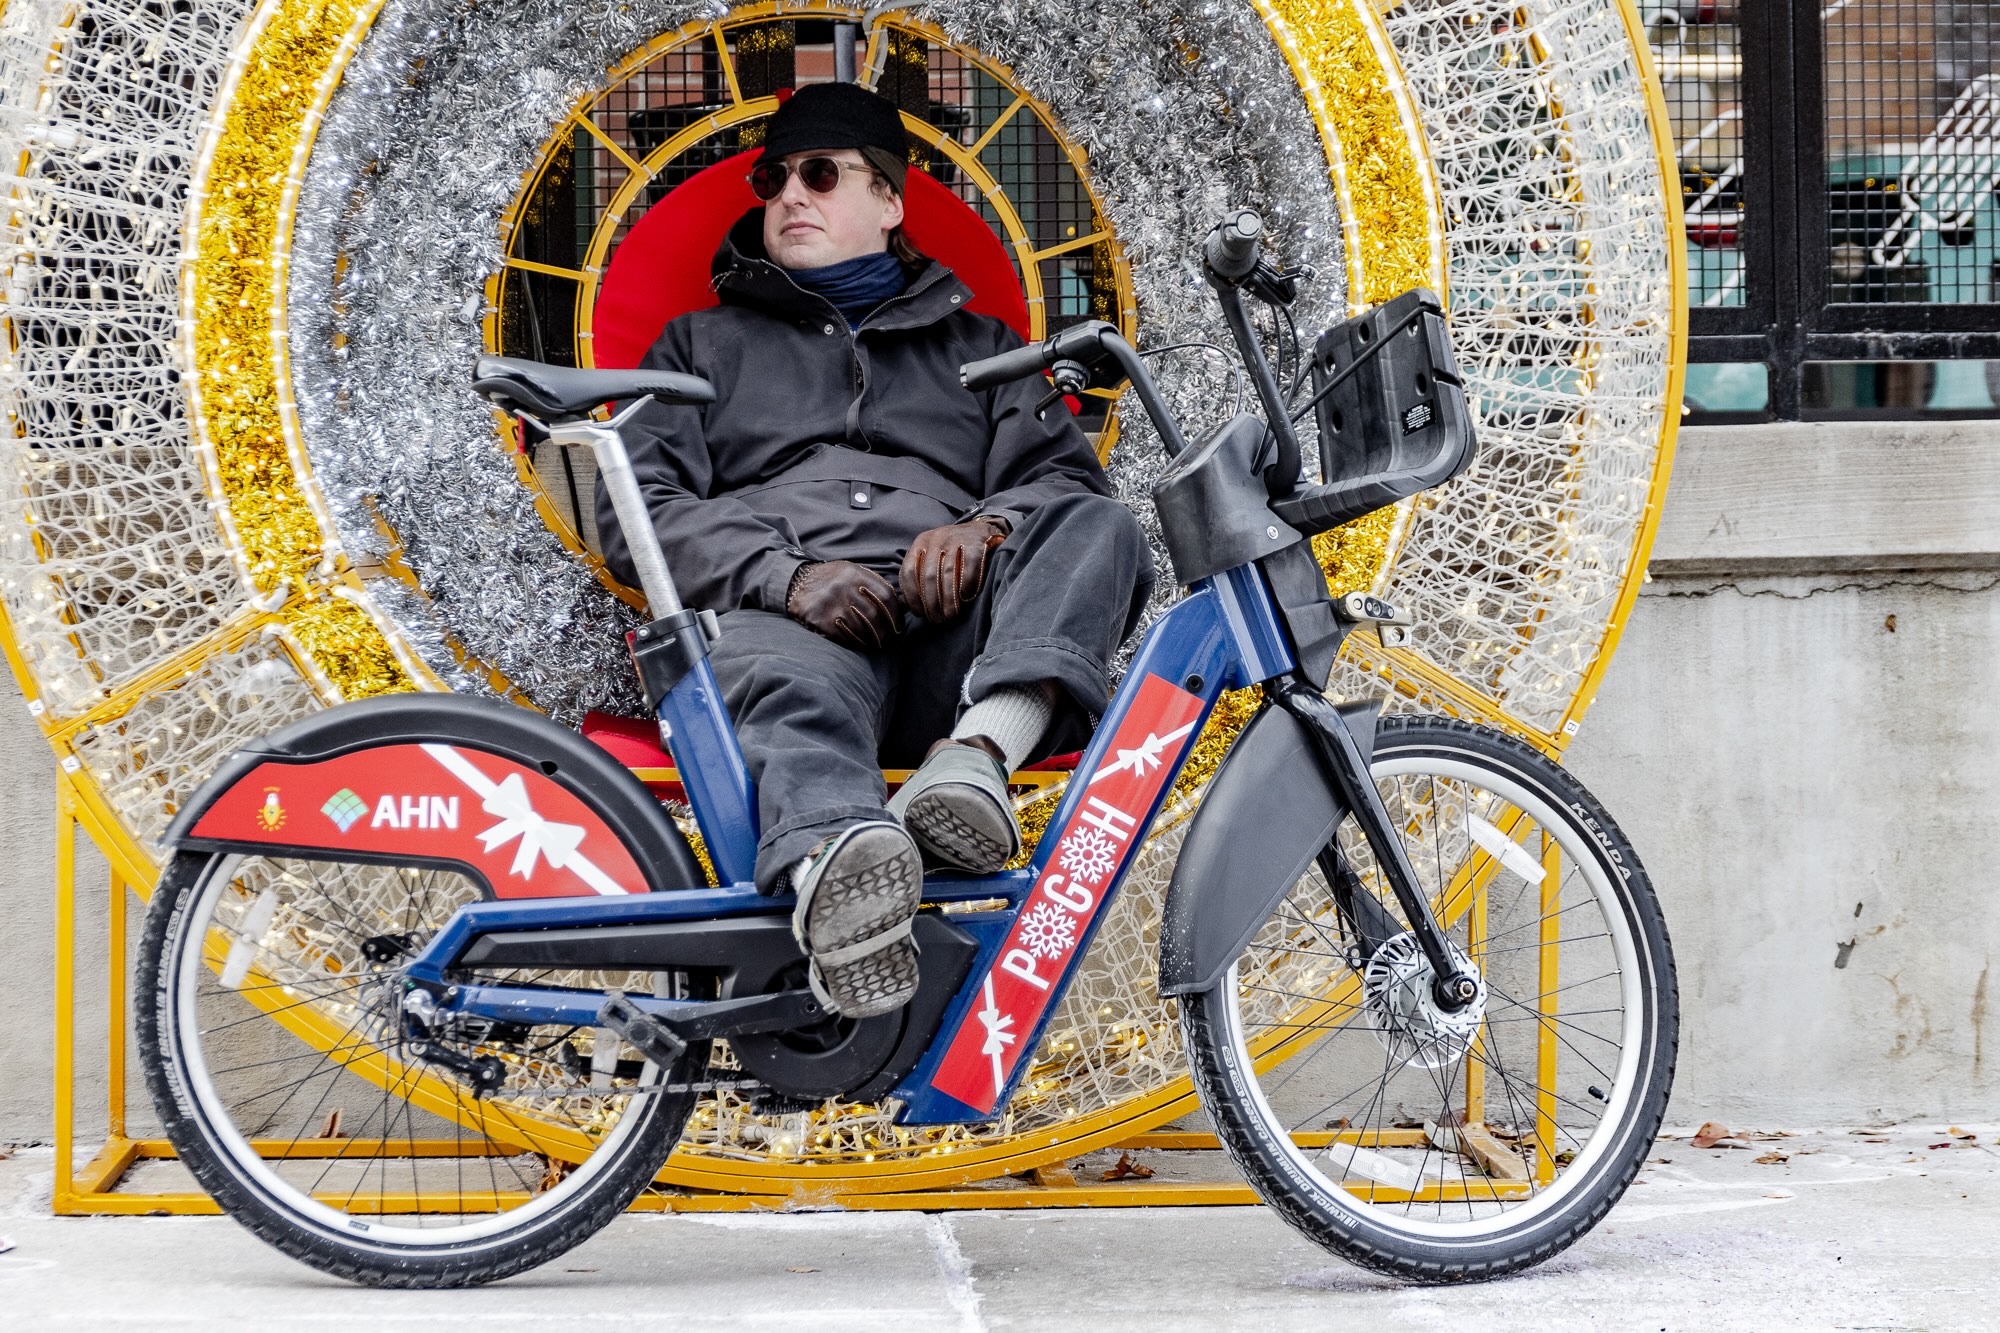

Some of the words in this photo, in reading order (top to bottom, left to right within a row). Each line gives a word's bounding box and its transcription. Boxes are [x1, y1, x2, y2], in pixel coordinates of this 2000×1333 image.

[370, 795, 459, 829] AHN
[1570, 802, 1632, 880] KENDA
[156, 992, 171, 1058] DRUMLIN
[1265, 1140, 1311, 1193] DRUMLIN
